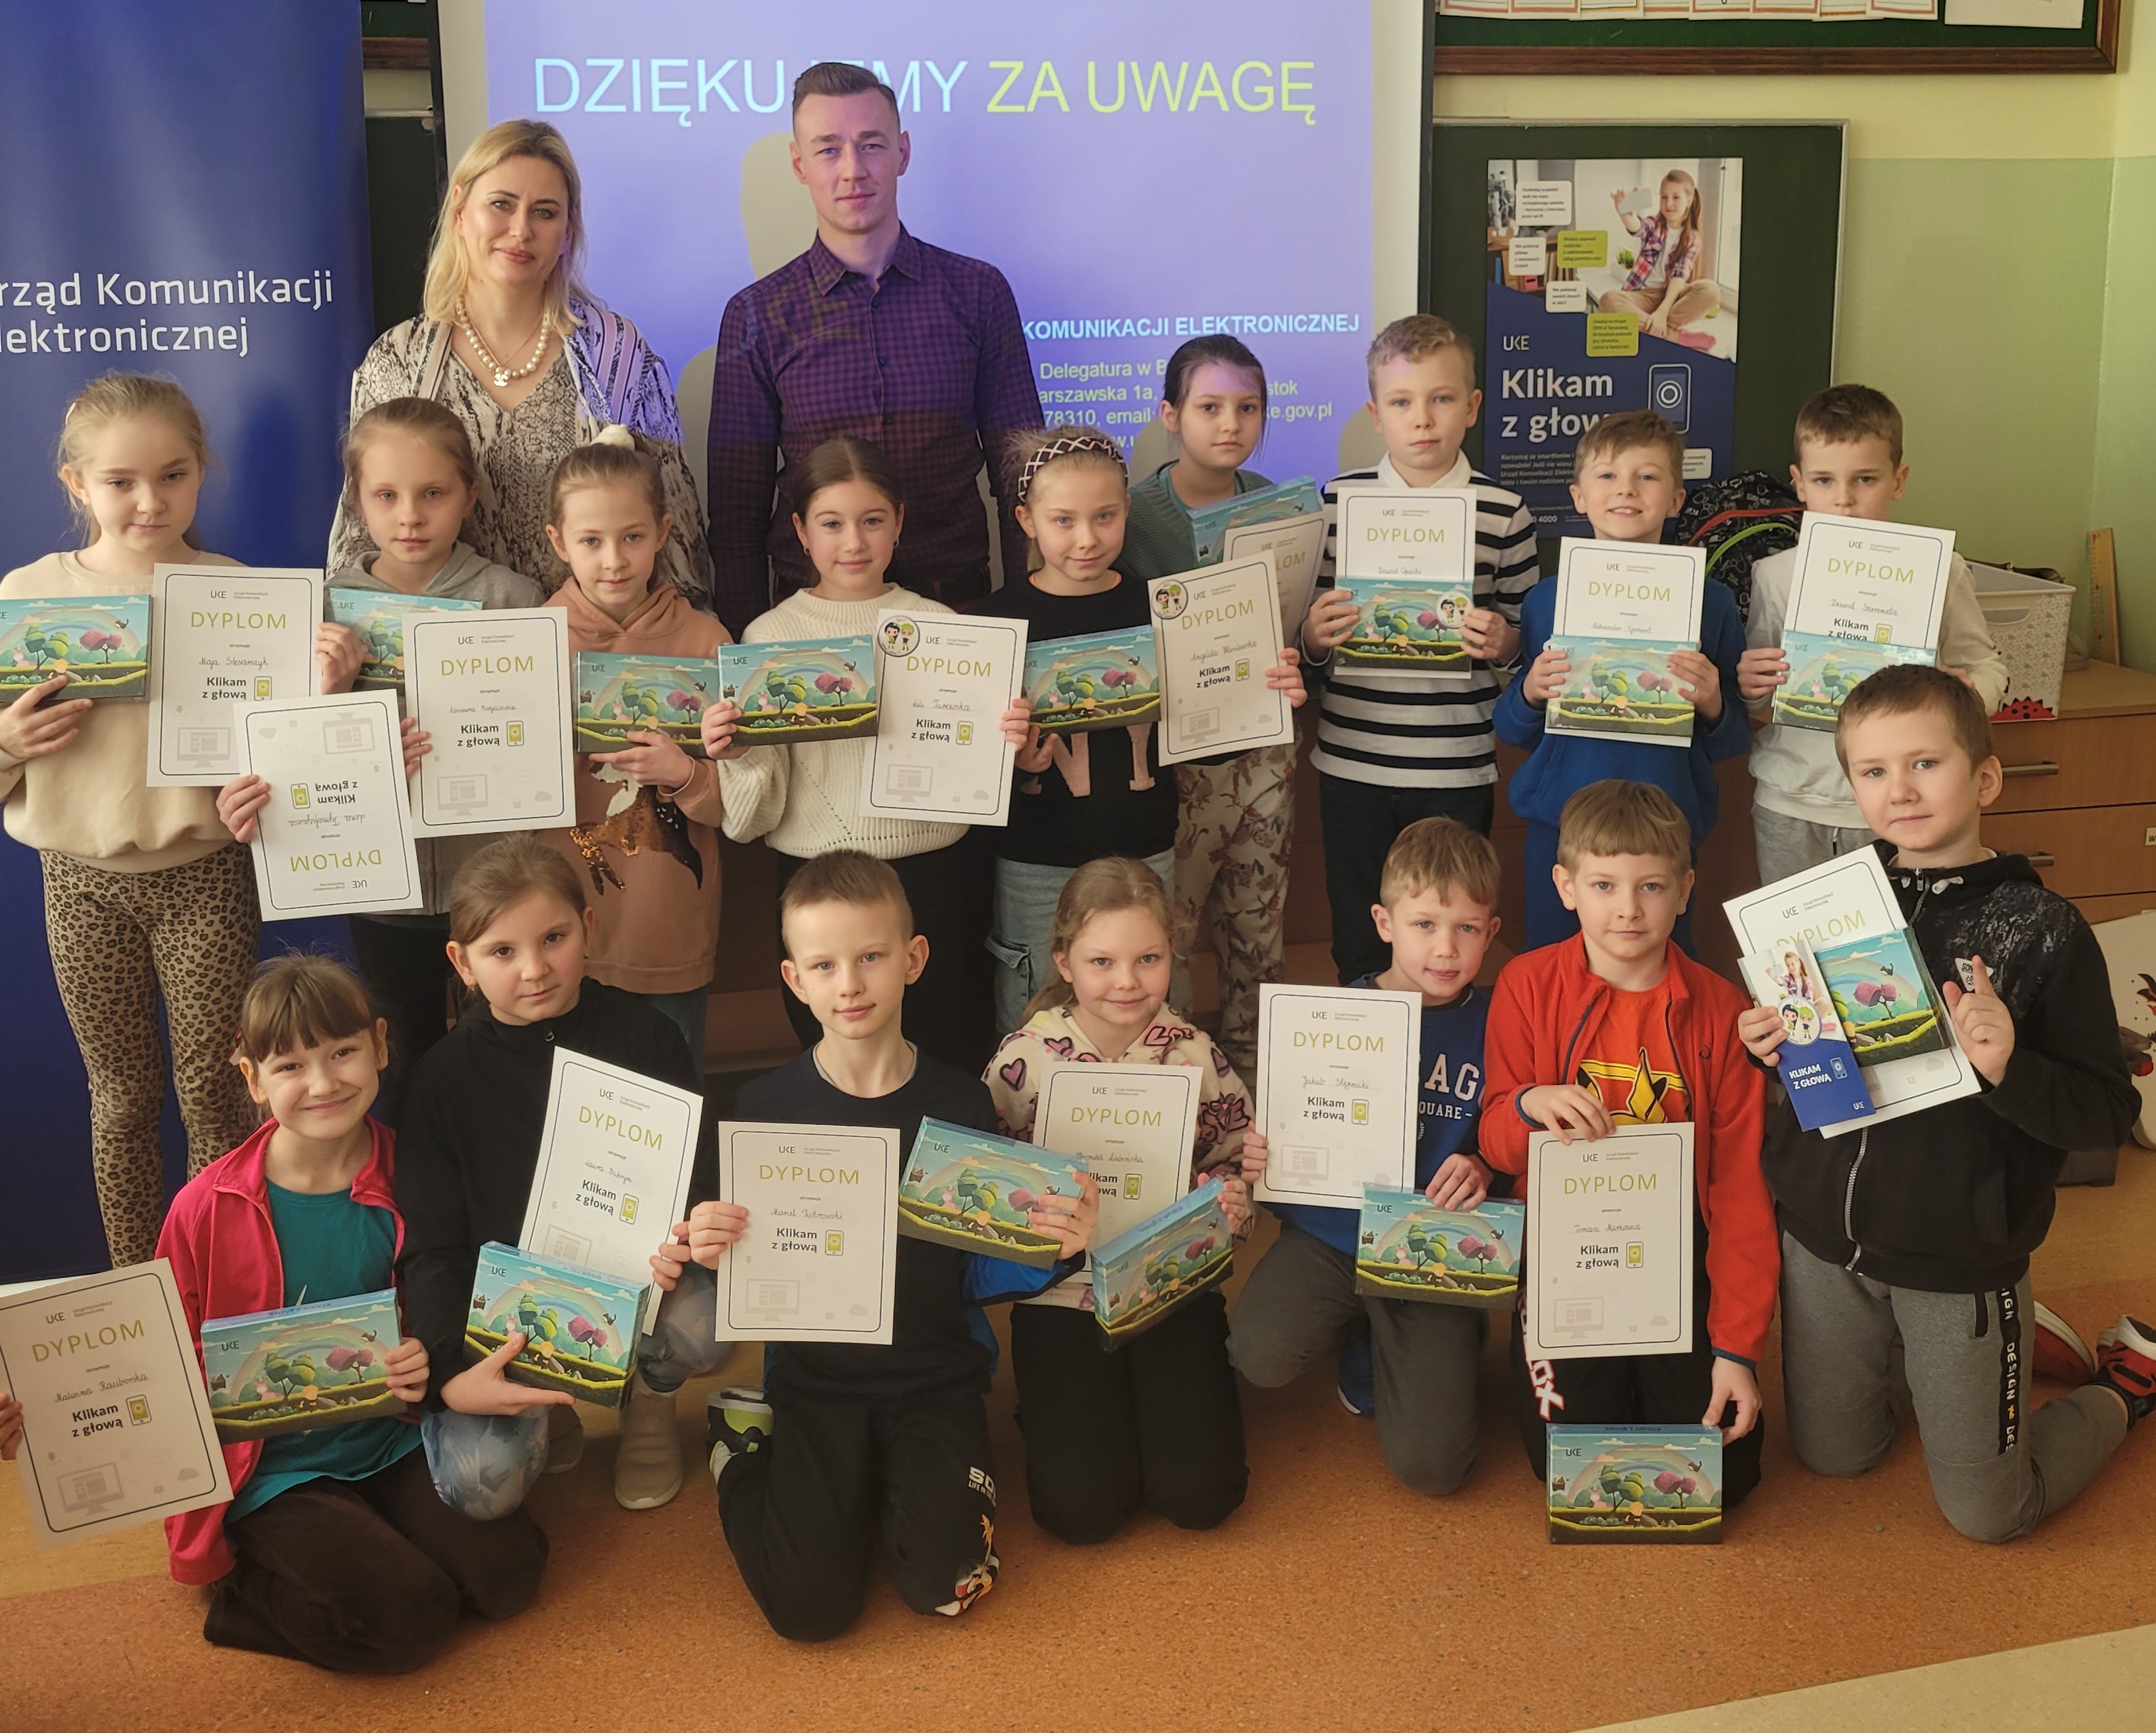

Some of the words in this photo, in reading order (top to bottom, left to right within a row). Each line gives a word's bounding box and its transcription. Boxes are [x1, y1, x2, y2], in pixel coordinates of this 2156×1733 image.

[534, 57, 968, 128] DZIĘKUMY
[986, 61, 1068, 113] ZA
[1087, 60, 1318, 127] UWAGĘ
[0, 272, 81, 315] rząd
[97, 269, 333, 311] Komunikacji
[1022, 317, 1169, 340] KOMUNIKACJI
[1174, 313, 1360, 336] ELEKTRONICZNEJ
[1503, 334, 1530, 351] UKE
[1040, 361, 1132, 382] Delegatura
[1136, 362, 1151, 376] w
[1156, 359, 1167, 376] B
[1501, 367, 1613, 399] Klikam
[1037, 385, 1127, 403] arszawska
[1133, 384, 1158, 402] 1a,
[1266, 379, 1299, 396] stok
[1266, 401, 1333, 423] e.gov.pl
[1501, 415, 1519, 438] z
[1528, 406, 1609, 443] głow
[1538, 515, 1558, 523] 4000
[1366, 528, 1445, 543] DYPLOM
[1275, 551, 1306, 570] LOM
[1827, 557, 1914, 585] DYPLOM
[210, 590, 227, 599] UKE
[1587, 580, 1671, 602] DYPLOM
[190, 611, 287, 630] DYPLOM
[1181, 599, 1255, 630] DYPLOM
[1833, 617, 1869, 632] Klikam
[458, 635, 474, 646] UKE
[925, 635, 941, 646] UKE
[1827, 629, 1834, 638] z
[440, 655, 535, 677] DYPLOM
[905, 655, 992, 678] DYPLOM
[1198, 664, 1231, 677] Klikam
[206, 677, 247, 688] Klikam
[1196, 680, 1202, 689] z
[1203, 675, 1231, 688] głową
[201, 691, 208, 699] z
[211, 689, 247, 701] głową
[460, 724, 500, 734] Klikam
[915, 719, 952, 731] Klikam
[457, 739, 463, 747] z
[466, 736, 500, 749] głową
[910, 731, 916, 740] z
[918, 730, 950, 743] głową
[314, 780, 349, 793] głową
[351, 781, 359, 790] z
[317, 793, 356, 806] Klikam
[289, 849, 383, 873] DYPLOM
[1782, 905, 1799, 919] UKE
[1311, 1010, 1328, 1020] UKE
[1293, 1031, 1385, 1053] DYPLOM
[1424, 1052, 1481, 1102] AG
[1788, 1063, 1822, 1079] KLIKAM
[1792, 1081, 1801, 1091] Z
[1800, 1073, 1833, 1088] GŁOWĄ
[599, 1088, 615, 1101] UKE
[1092, 1086, 1109, 1096] UKE
[1307, 1096, 1345, 1109] Klikam
[1070, 1106, 1163, 1128] DYPLOM
[1303, 1109, 1310, 1119] z
[1312, 1109, 1345, 1122] głową
[1419, 1101, 1463, 1120] QUARE
[578, 1105, 663, 1152] DYPLOM
[779, 1146, 796, 1154] UKE
[1583, 1153, 1599, 1163] UKE
[759, 1164, 860, 1186] DYPLOM
[581, 1178, 617, 1201] Klikam
[1563, 1173, 1658, 1195] DYPLOM
[575, 1193, 582, 1203] z
[582, 1195, 615, 1216] głową
[776, 1227, 818, 1240] Klikam
[771, 1241, 778, 1250] z
[781, 1241, 818, 1254] głową
[1580, 1244, 1620, 1255] Klikam
[1576, 1259, 1583, 1269] z
[1585, 1257, 1620, 1270] głową
[491, 1265, 508, 1278] UKE
[2000, 1287, 2014, 1321] IGN
[45, 1311, 67, 1325] UKE
[30, 1319, 145, 1363] DYPLOM
[221, 1339, 240, 1352] UKE
[2006, 1341, 2018, 1401] DESIGN
[71, 1402, 120, 1423] Klikam
[71, 1426, 80, 1438] z
[82, 1416, 124, 1438] głową
